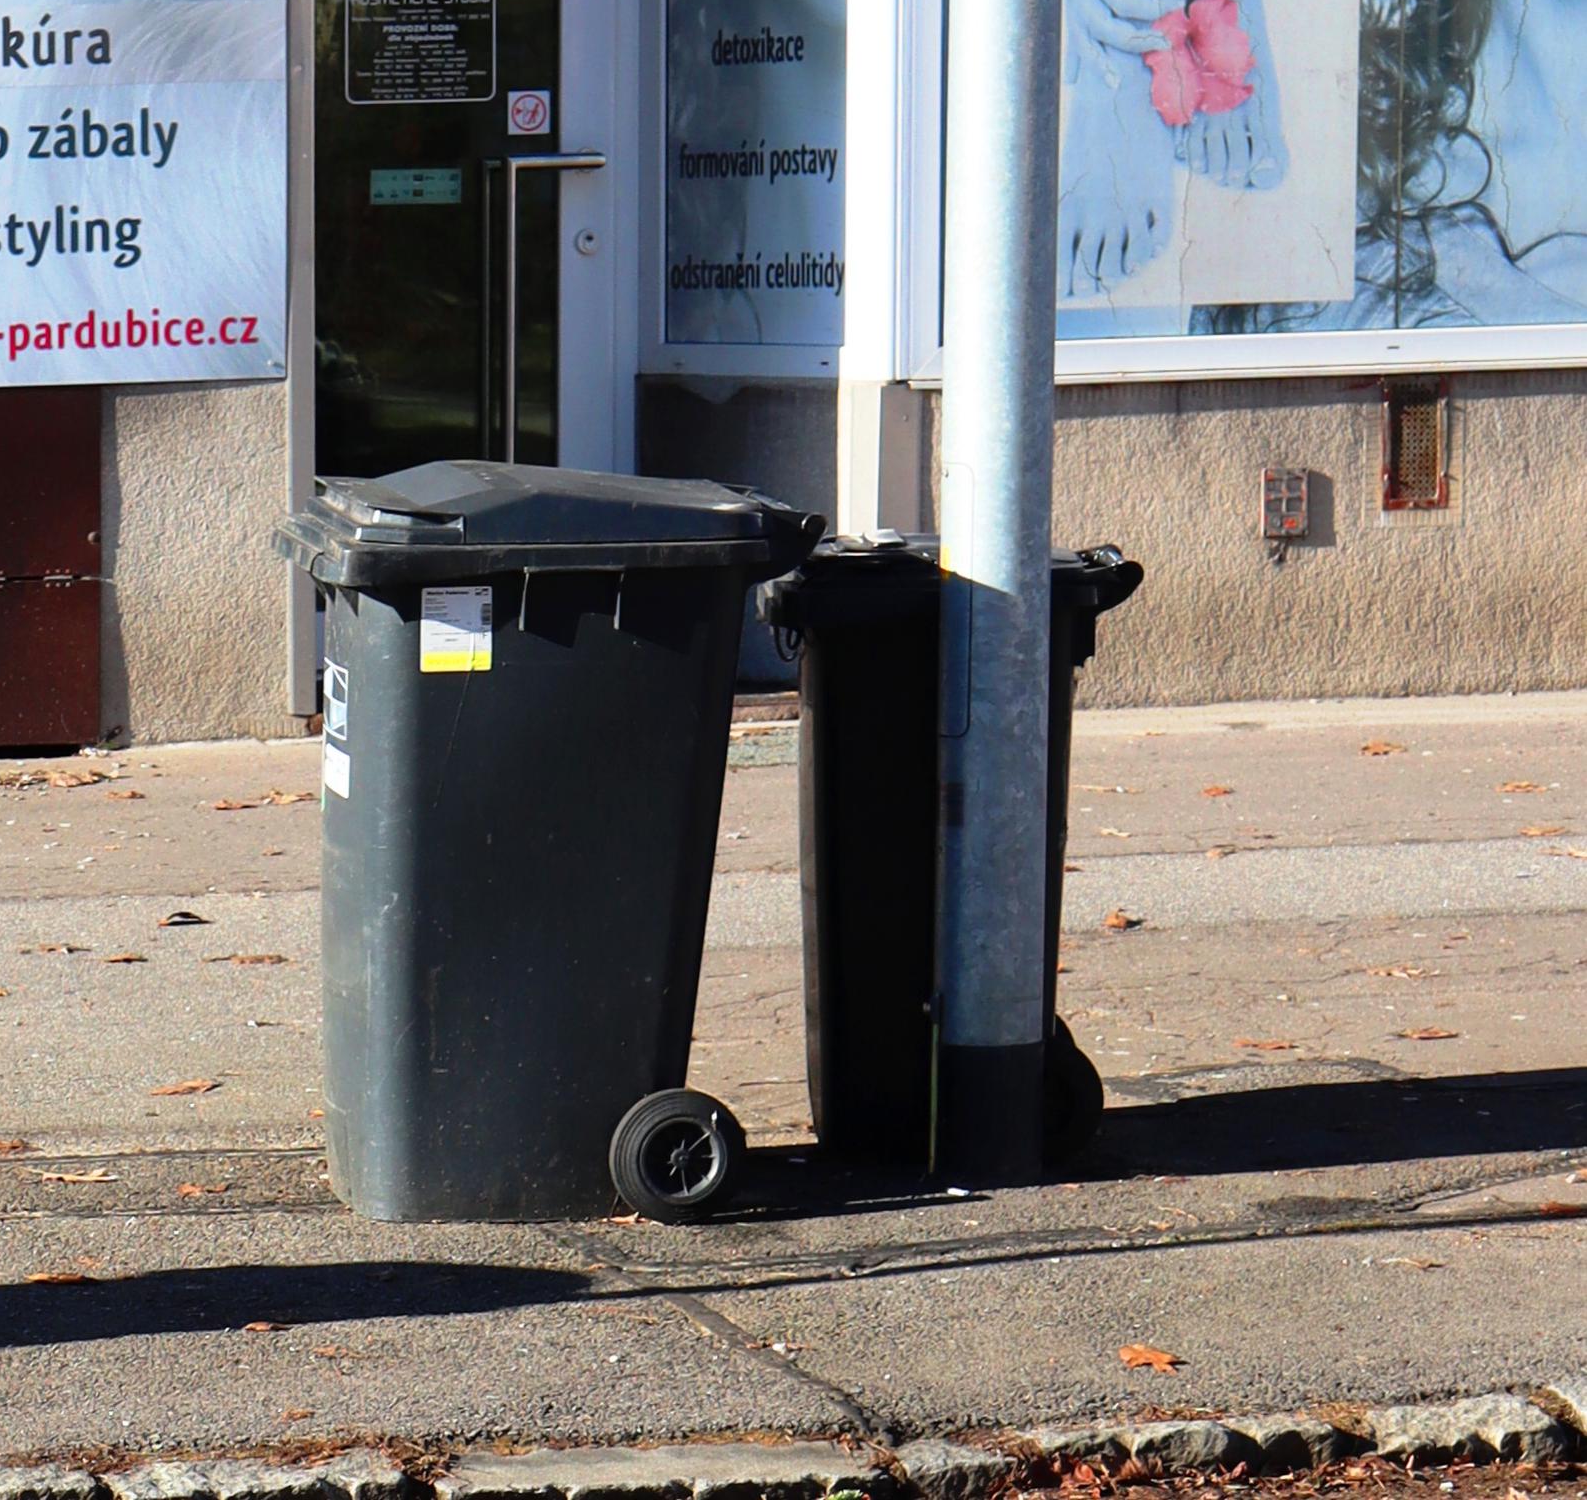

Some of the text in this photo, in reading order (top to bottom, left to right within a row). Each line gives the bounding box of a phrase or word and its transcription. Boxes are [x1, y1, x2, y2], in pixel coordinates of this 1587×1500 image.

[712, 26, 804, 66] detoxikace
[28, 108, 178, 167] zábaly
[679, 140, 837, 185] formování postavy
[671, 248, 845, 296] odstranění celulitidy
